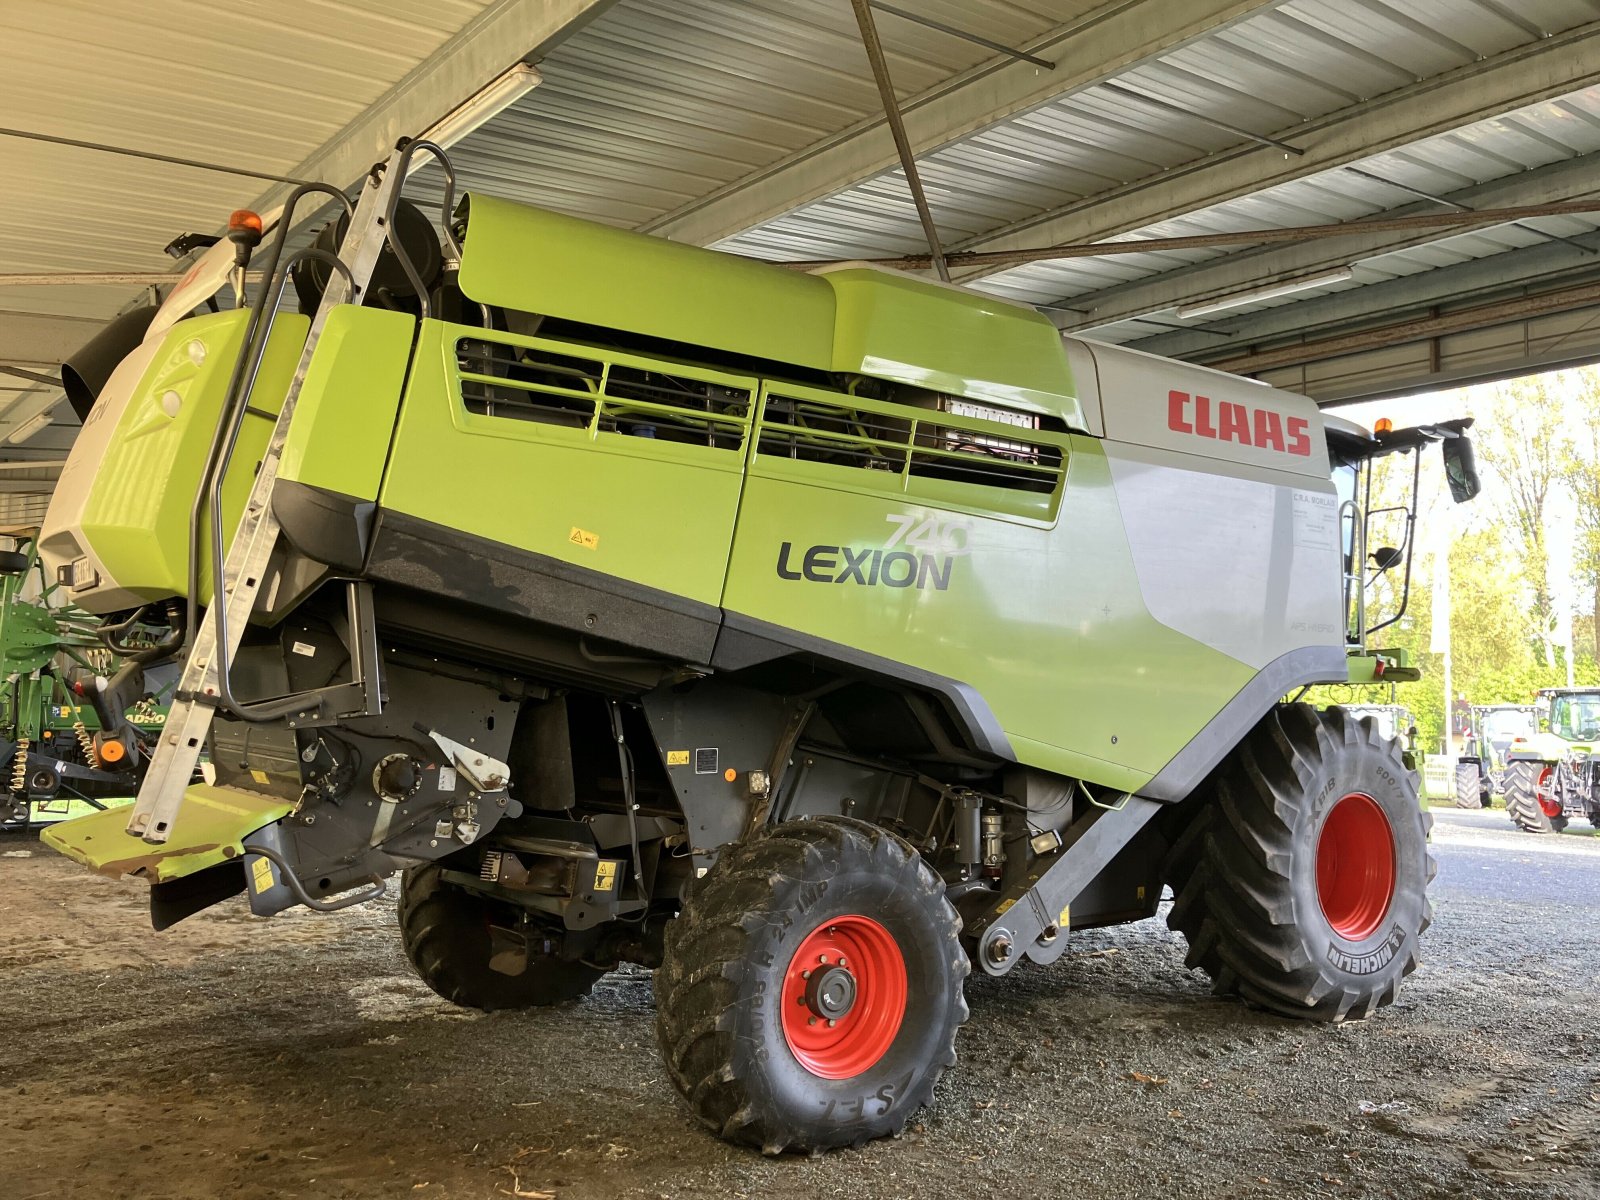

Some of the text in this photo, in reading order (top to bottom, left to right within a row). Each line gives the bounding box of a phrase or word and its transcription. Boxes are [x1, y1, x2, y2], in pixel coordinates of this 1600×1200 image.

[1168, 390, 1310, 456] CLAAS
[776, 542, 953, 590] LEXION
[1327, 942, 1393, 974] MICHELIN
